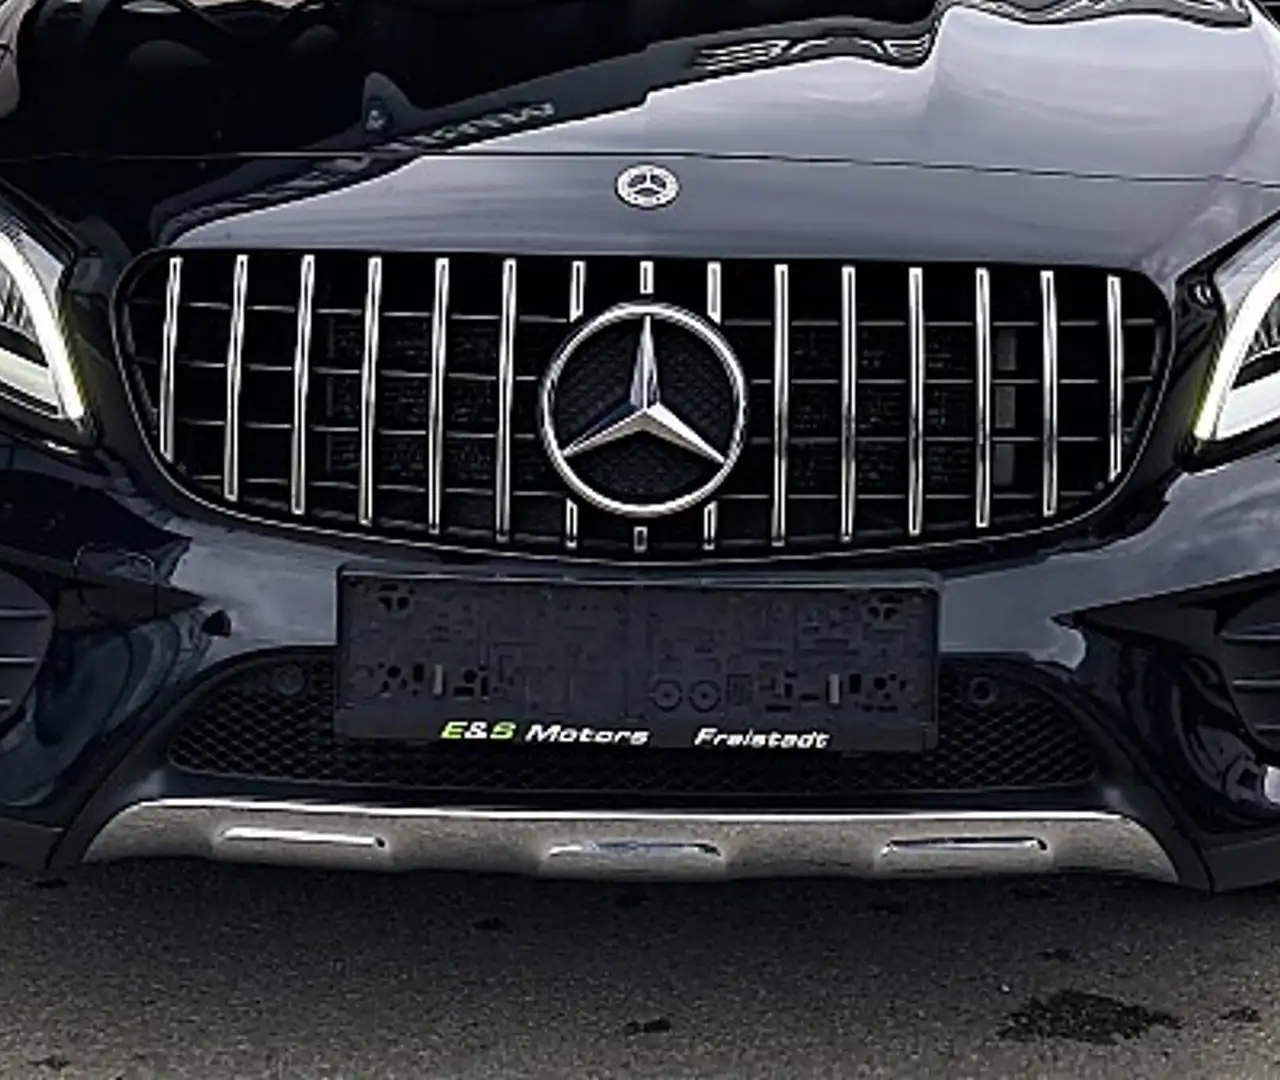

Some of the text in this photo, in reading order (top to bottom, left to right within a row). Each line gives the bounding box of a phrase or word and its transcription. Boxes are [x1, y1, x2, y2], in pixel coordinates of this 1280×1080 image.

[440, 721, 831, 749] E&S Motors Freistadt
